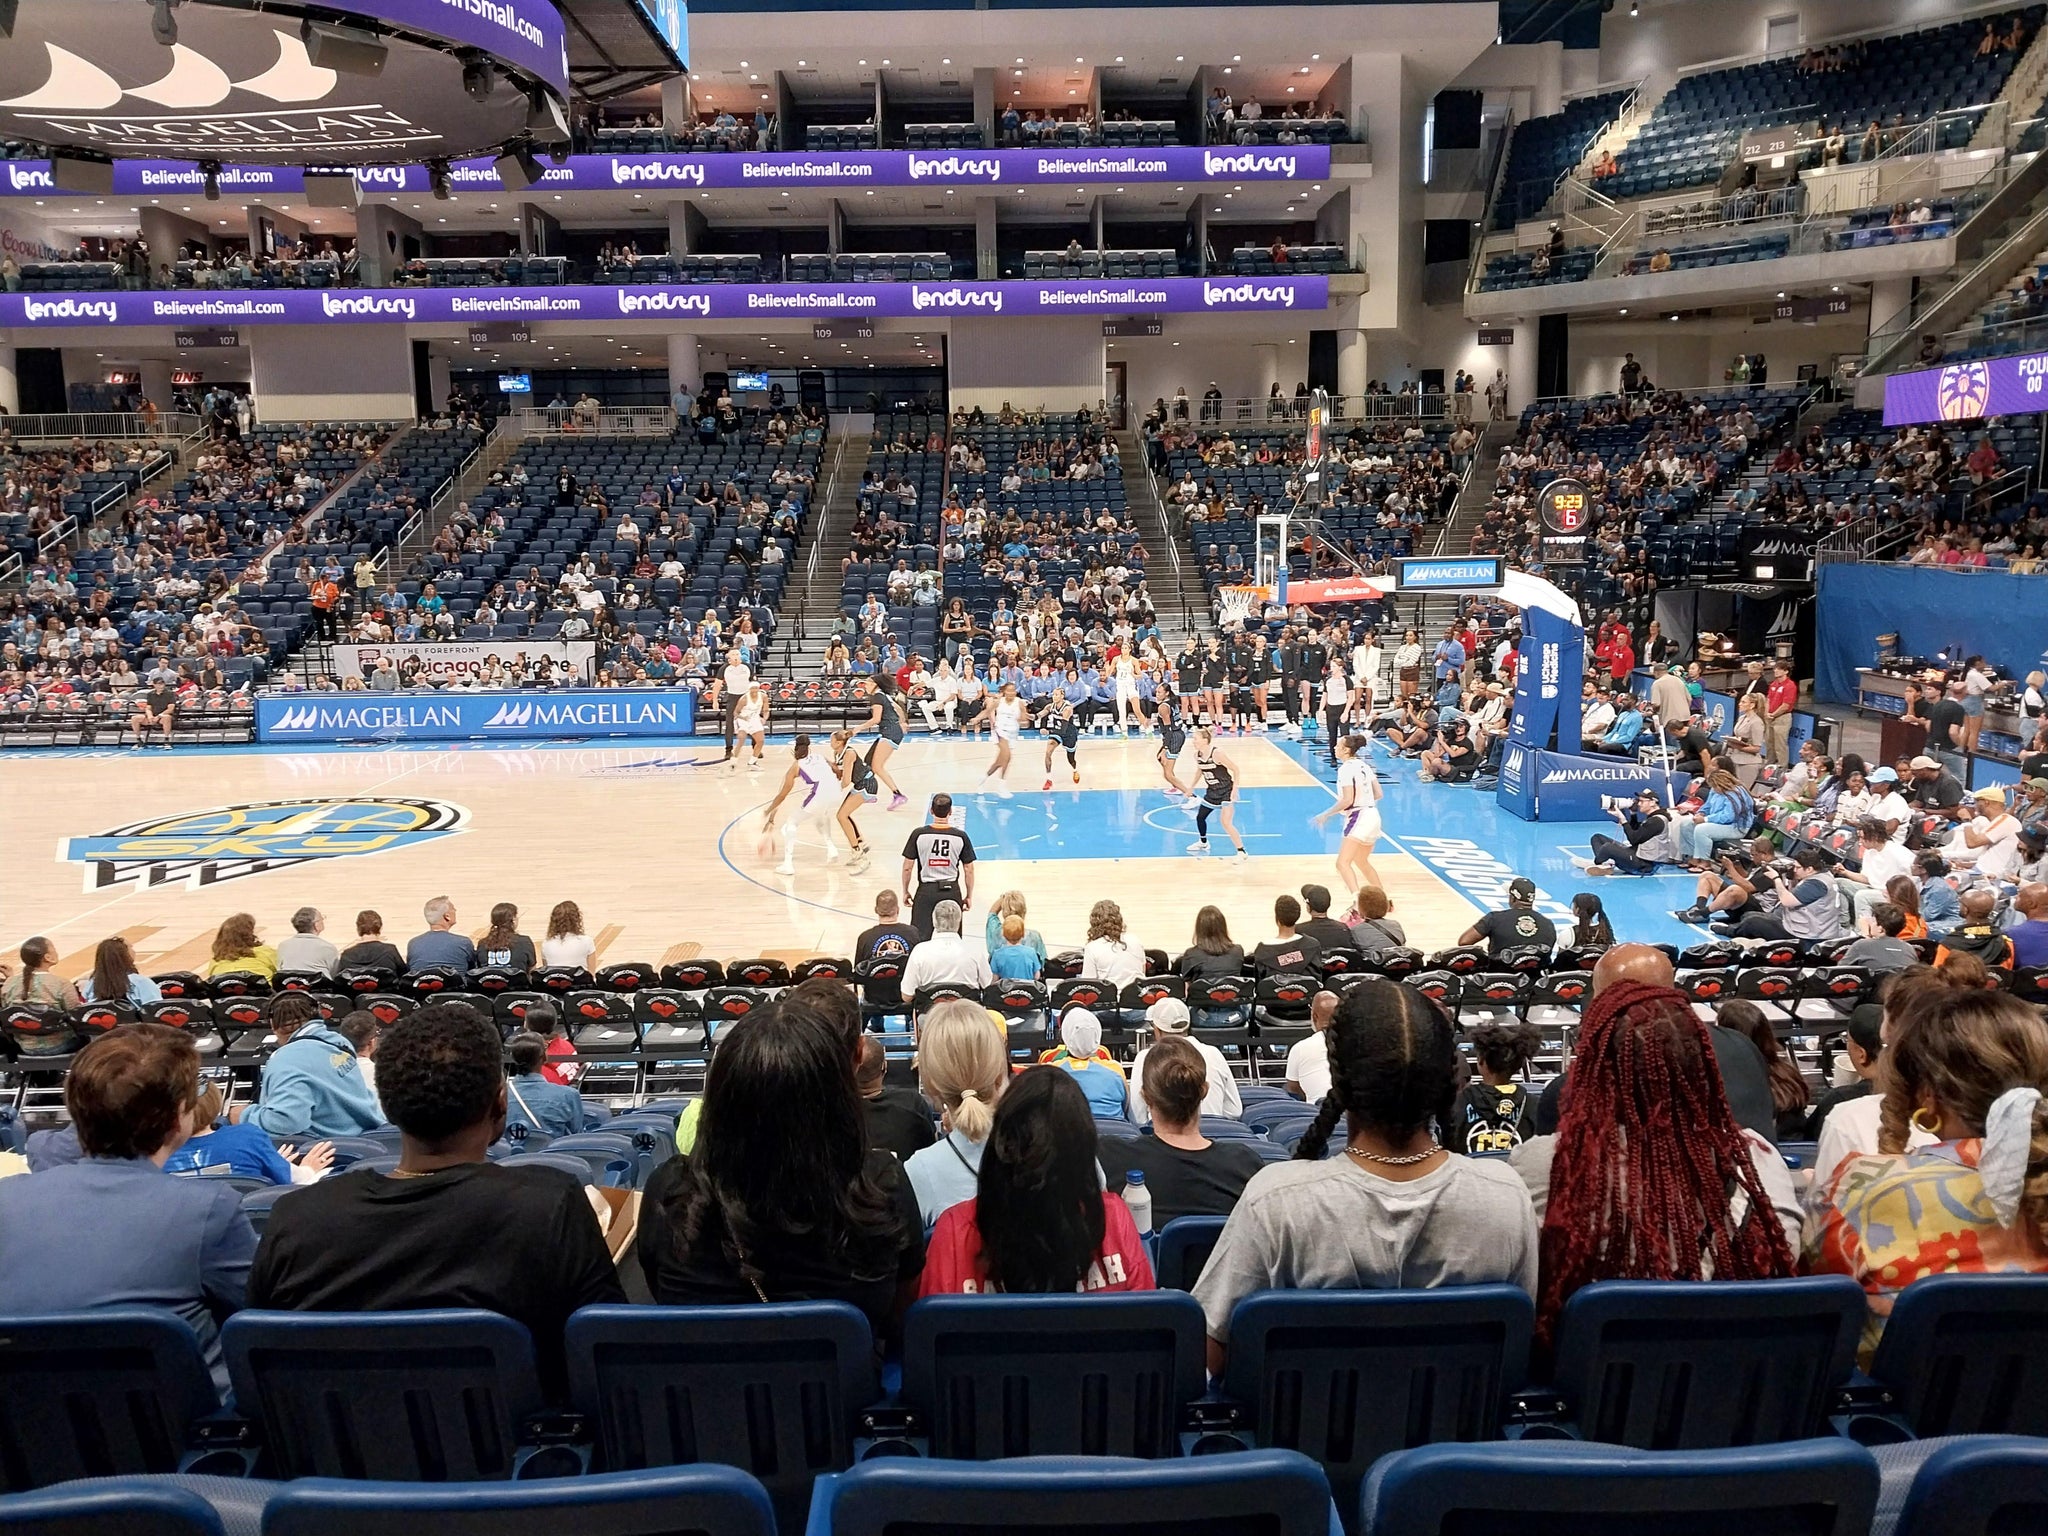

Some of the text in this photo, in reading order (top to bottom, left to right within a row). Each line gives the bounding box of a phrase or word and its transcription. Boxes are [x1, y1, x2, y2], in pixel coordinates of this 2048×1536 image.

[45, 111, 412, 137] MAGELLAN
[88, 126, 432, 143] CORPORATION
[1745, 144, 1761, 156] 212
[1768, 140, 1785, 152] 213
[611, 158, 705, 186] lendistry
[742, 161, 872, 178] BelieveInSmall.com
[908, 154, 1001, 181] lendistry
[1037, 157, 1167, 175] BelieveInSmall.com
[1204, 150, 1296, 178] lendistry
[142, 168, 273, 185] BelieveInmall.com
[618, 289, 710, 316] lendistry
[748, 293, 876, 310] BelieveInSmall.com
[912, 285, 1002, 312] lendistry
[1039, 288, 1167, 306] BelieveInSmall.com
[1203, 281, 1295, 308] lendistry
[23, 295, 117, 322] lendistry
[153, 299, 285, 316] BelieveInSmall.com
[322, 292, 416, 319] lendistry
[452, 296, 581, 313] BelieveInSmall.com
[1776, 300, 1846, 318] 113 114
[471, 332, 528, 342] 108 109
[815, 328, 872, 339] 109 110
[1104, 324, 1161, 335] 111 112
[177, 335, 235, 346] 106 107
[1480, 335, 1492, 344] 112
[2018, 356, 2048, 376] FOU
[110, 370, 203, 384] CHAONS
[2027, 375, 2043, 393] 00
[1554, 494, 1584, 510] 9:23
[1565, 509, 1577, 526] 6
[1428, 567, 1494, 579] MAGELLAN
[424, 646, 481, 654] FOREFRONT
[1541, 642, 1551, 684] UChicago
[1550, 642, 1559, 684] Medicine
[320, 706, 461, 729] MAGELLAN
[534, 702, 677, 725] MAGELLAN
[1567, 768, 1650, 781] MAGELLAN
[86, 834, 398, 857] SKY
[931, 839, 950, 857] 42
